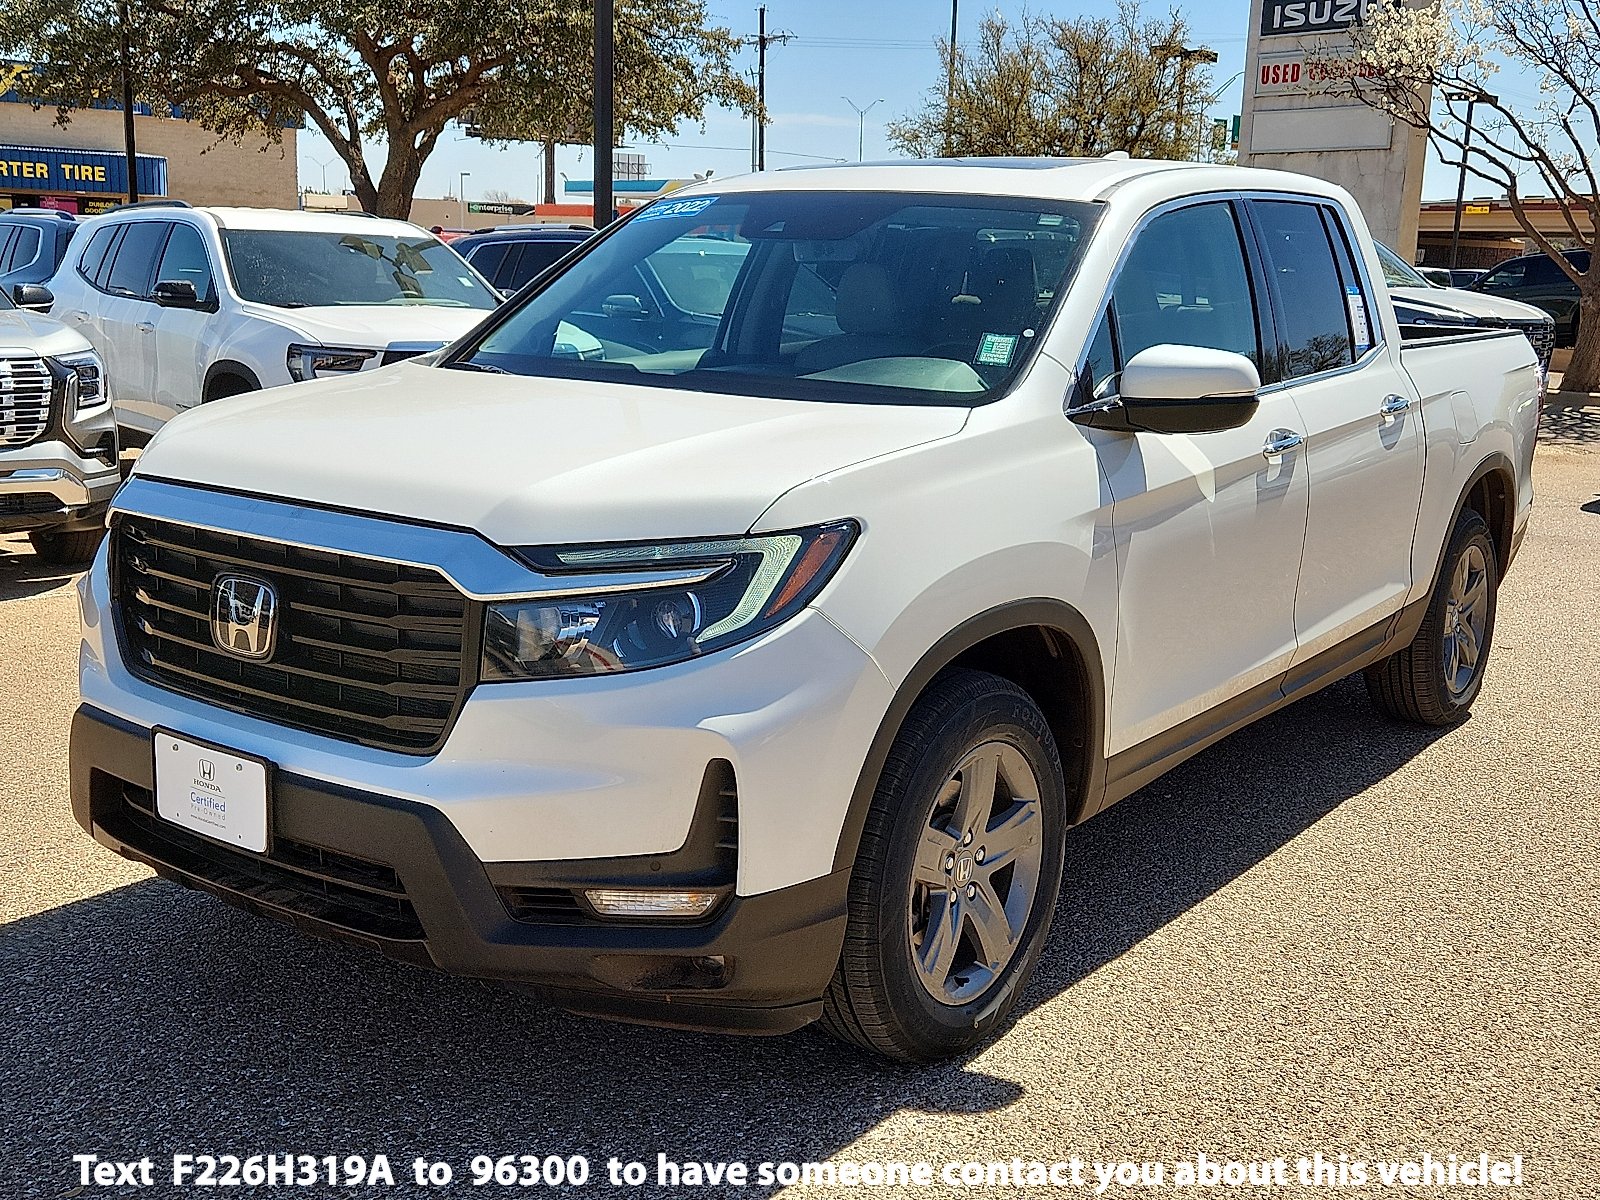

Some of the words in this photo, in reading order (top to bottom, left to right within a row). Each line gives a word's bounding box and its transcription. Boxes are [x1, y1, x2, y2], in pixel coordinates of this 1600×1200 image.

[1261, 63, 1300, 85] USED
[0, 160, 49, 179] RTER
[61, 163, 106, 182] TIRE
[470, 204, 514, 213] enterprise
[662, 199, 711, 215] 2022
[1011, 703, 1060, 772] FORTUNE
[193, 778, 222, 793] HONDA
[190, 791, 226, 813] Certified
